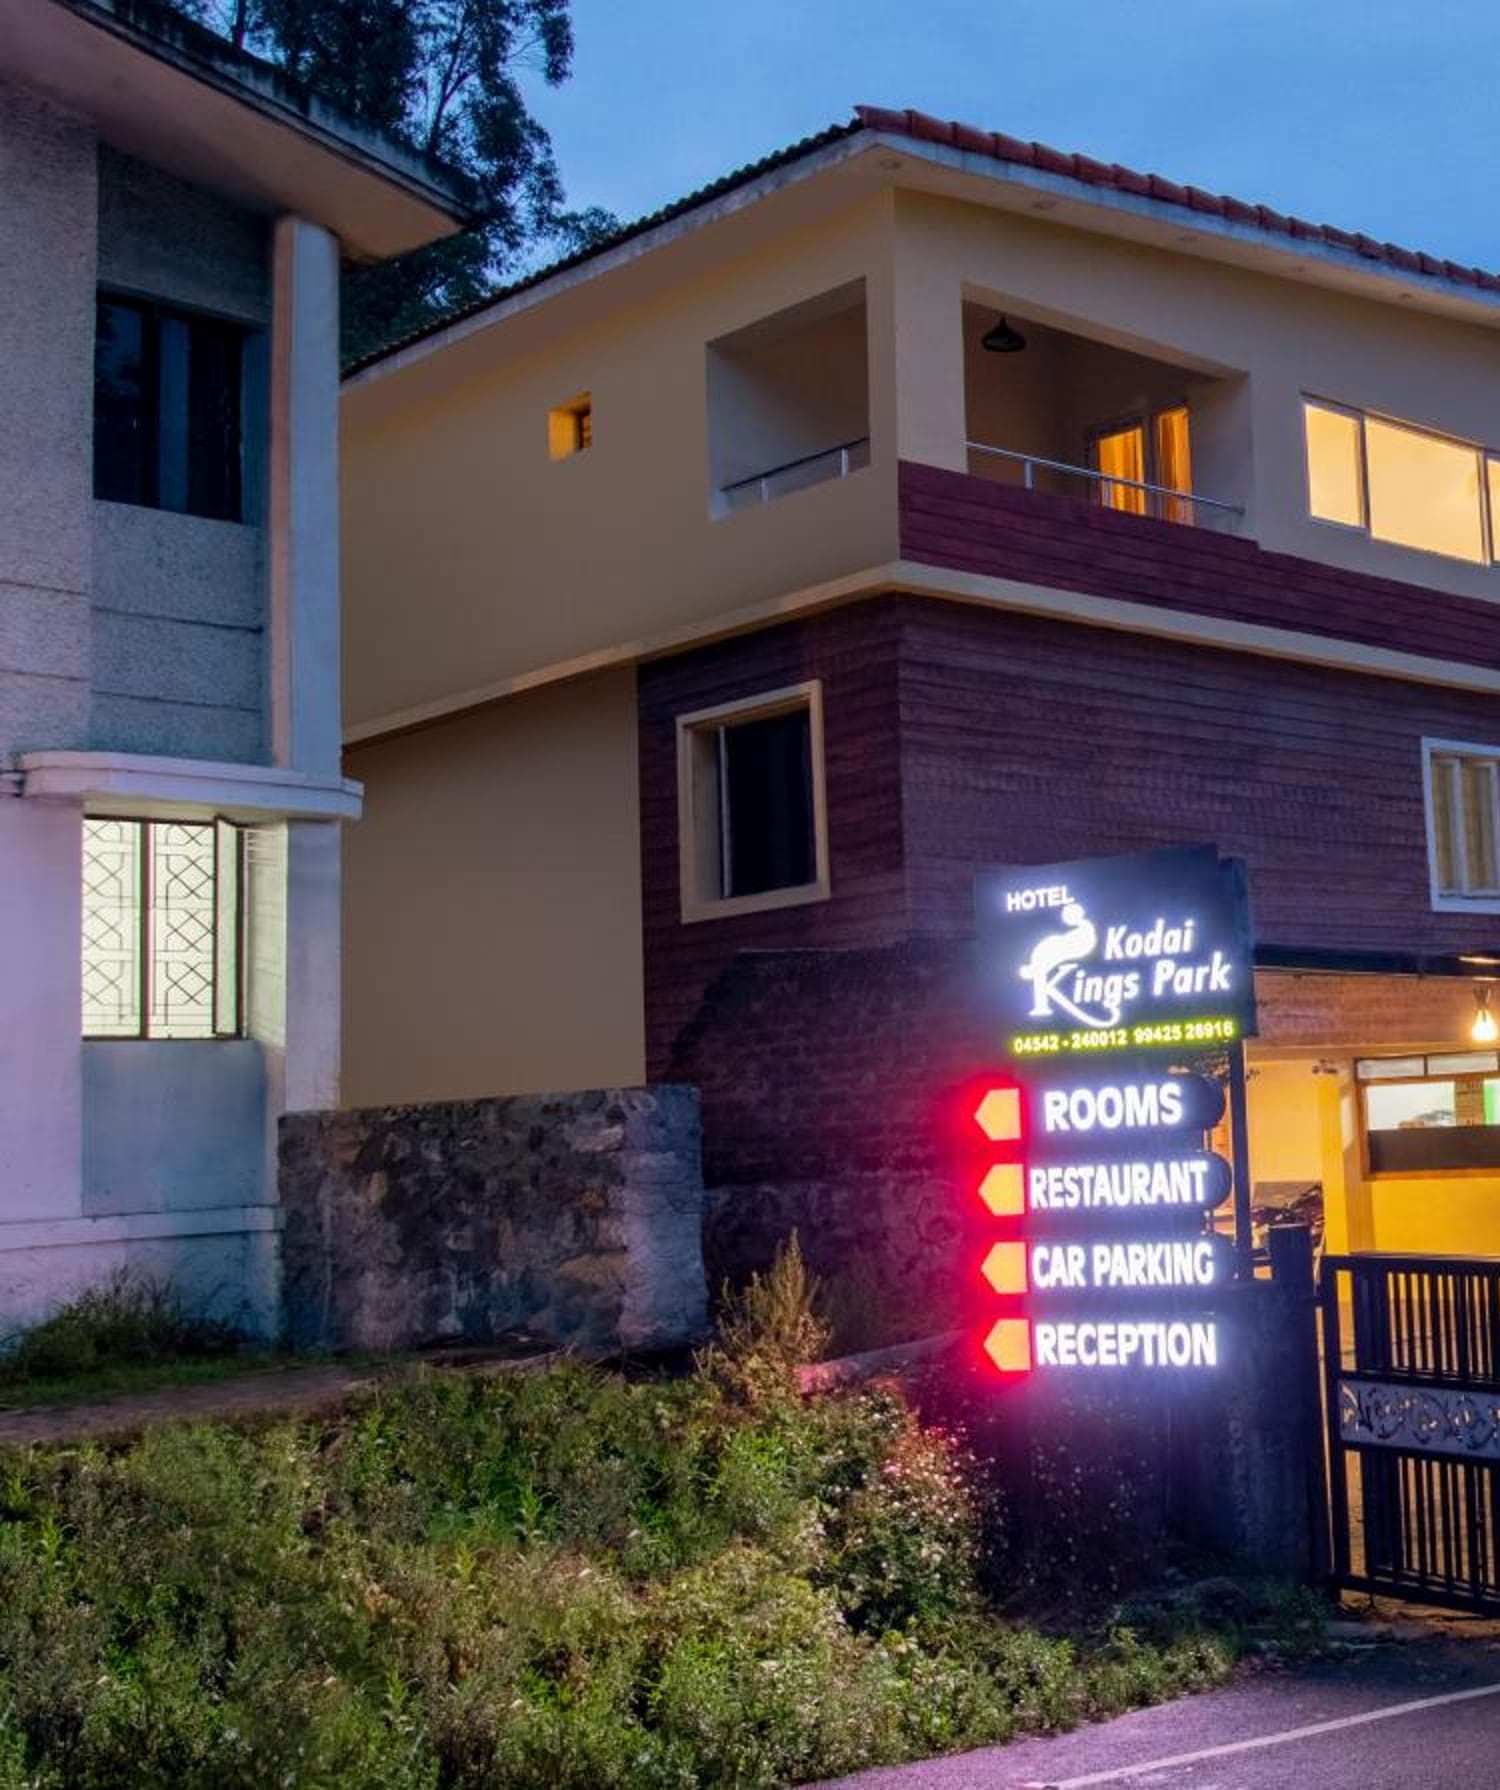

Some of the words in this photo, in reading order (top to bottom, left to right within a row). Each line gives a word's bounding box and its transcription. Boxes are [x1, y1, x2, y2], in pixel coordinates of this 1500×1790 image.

[1006, 886, 1074, 912] HOTEL
[1104, 918, 1194, 960] Kodai
[1026, 950, 1139, 1027] Kings
[1152, 950, 1232, 996] Park
[1044, 1082, 1183, 1132] ROOMS
[1030, 1160, 1208, 1208] RESTAURANT
[1032, 1246, 1086, 1287] CAR
[1092, 1242, 1215, 1286] PARKING
[1035, 1323, 1217, 1366] RECEPTION
